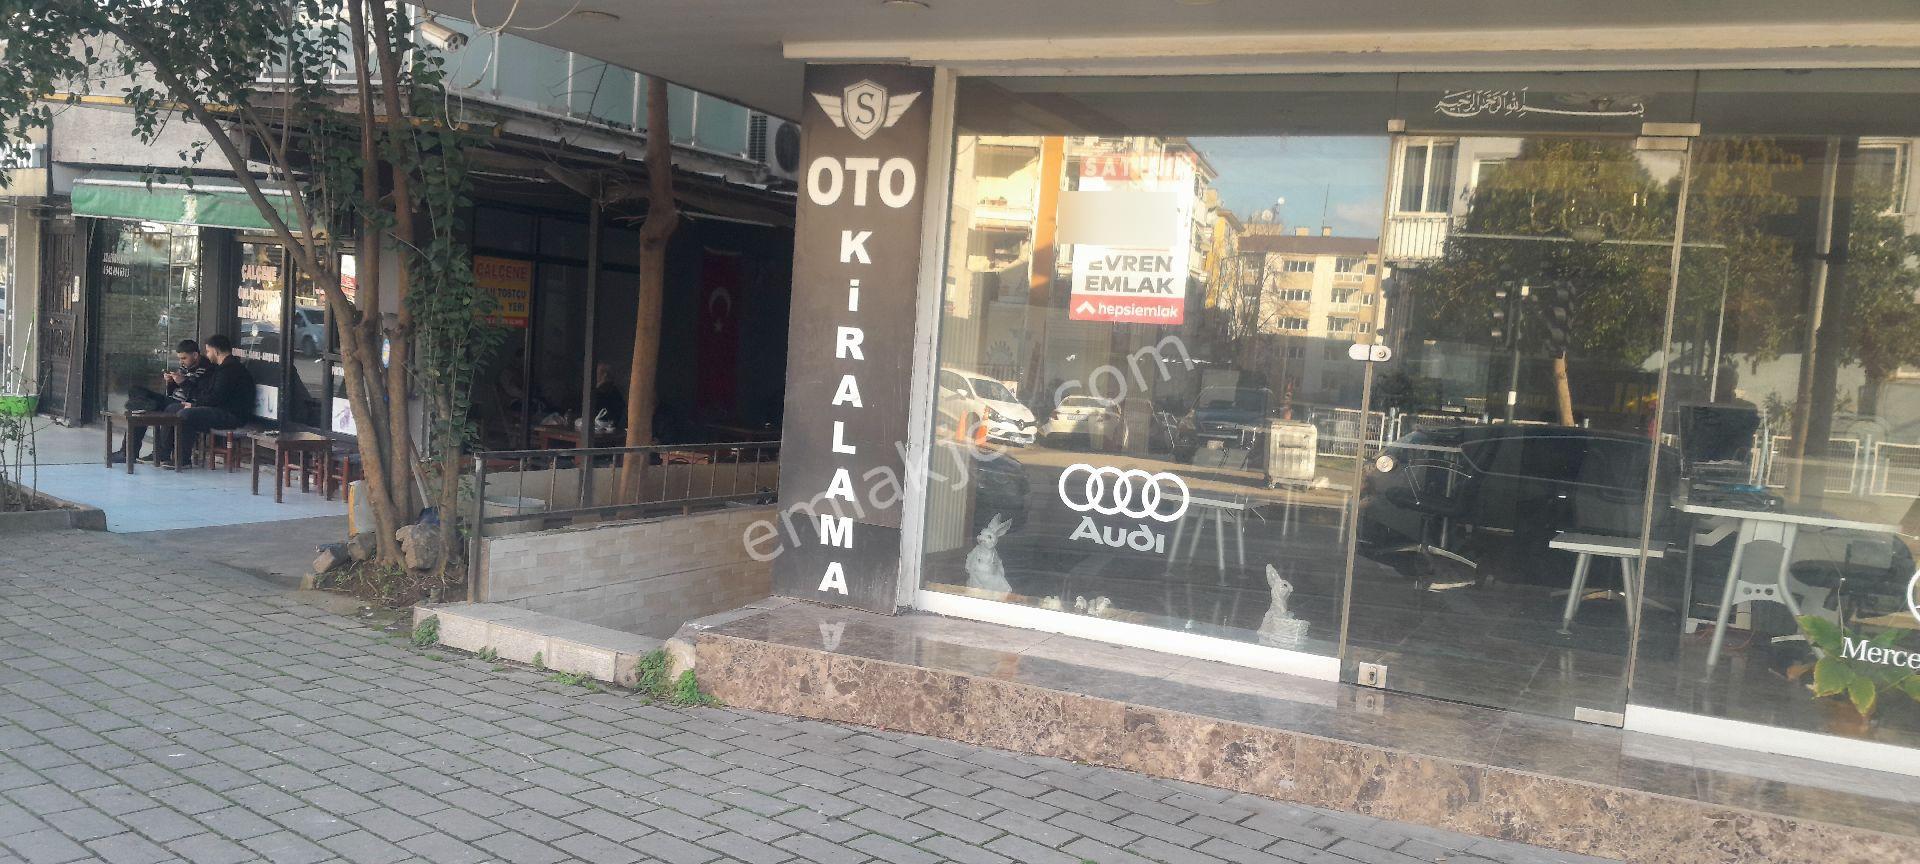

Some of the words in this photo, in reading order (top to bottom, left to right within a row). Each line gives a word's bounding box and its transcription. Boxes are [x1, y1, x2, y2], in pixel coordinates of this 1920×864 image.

[855, 92, 876, 125] S
[806, 156, 917, 209] OTO
[1089, 255, 1174, 273] EVREN
[1084, 275, 1175, 295] EMLAK
[1098, 302, 1178, 317] hepsiemlak
[1068, 515, 1165, 554] Audi
